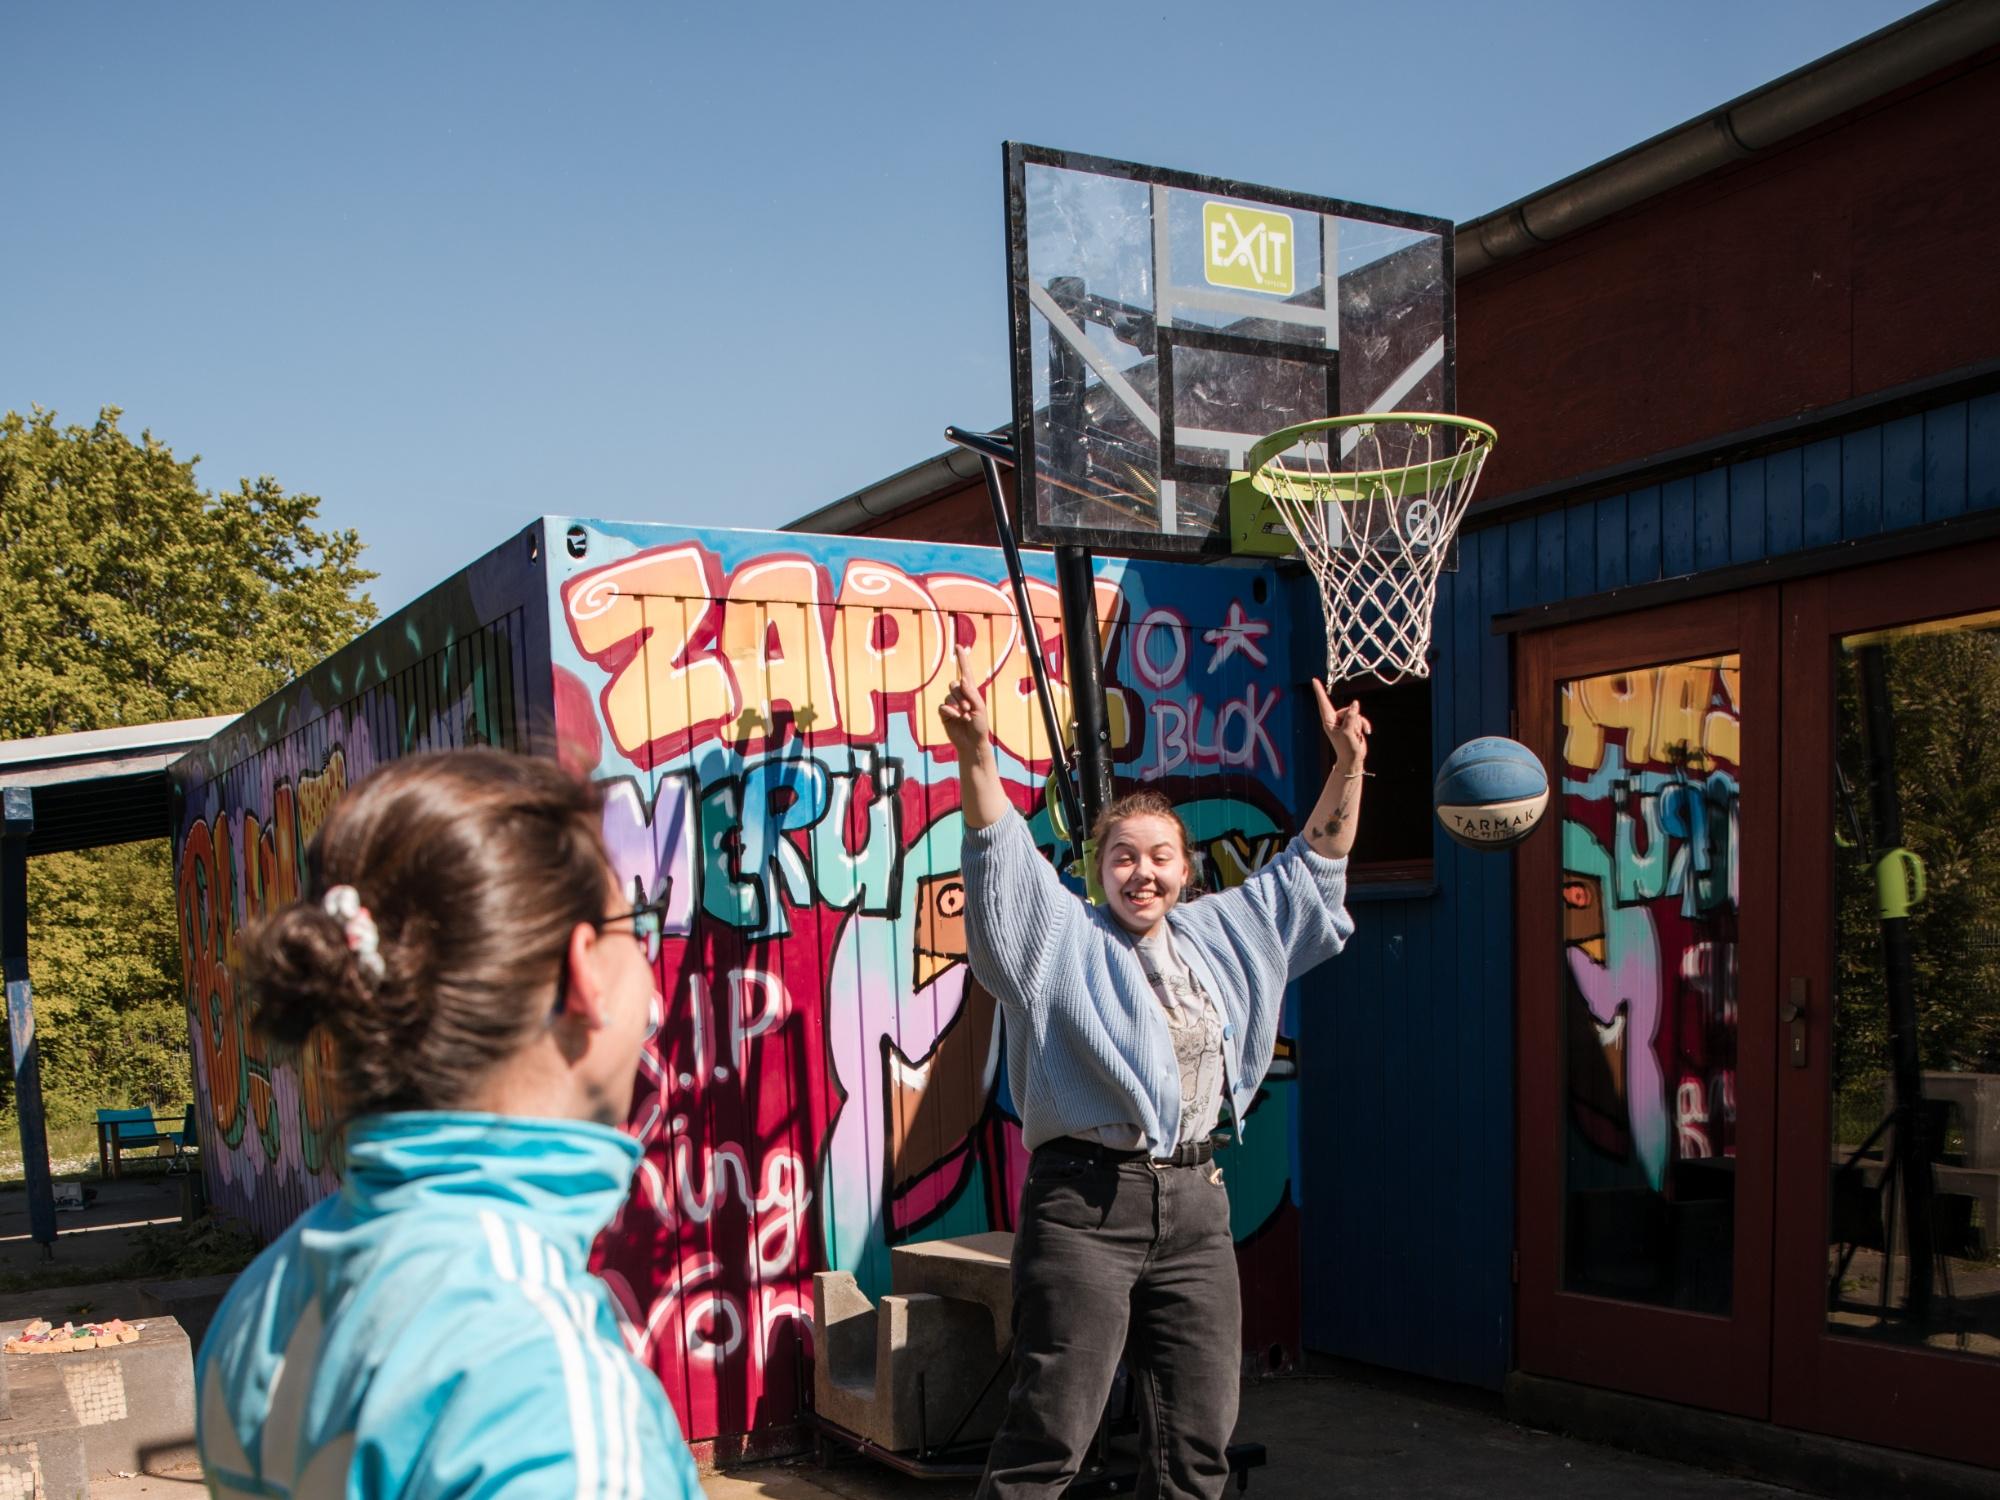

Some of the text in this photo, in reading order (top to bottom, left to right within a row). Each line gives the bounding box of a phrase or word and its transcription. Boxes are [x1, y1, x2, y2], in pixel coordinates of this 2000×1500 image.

[1211, 212, 1286, 284] EXIT
[1133, 606, 1190, 700] O
[1142, 684, 1286, 781] BLOK
[1454, 808, 1534, 831] TARMAK
